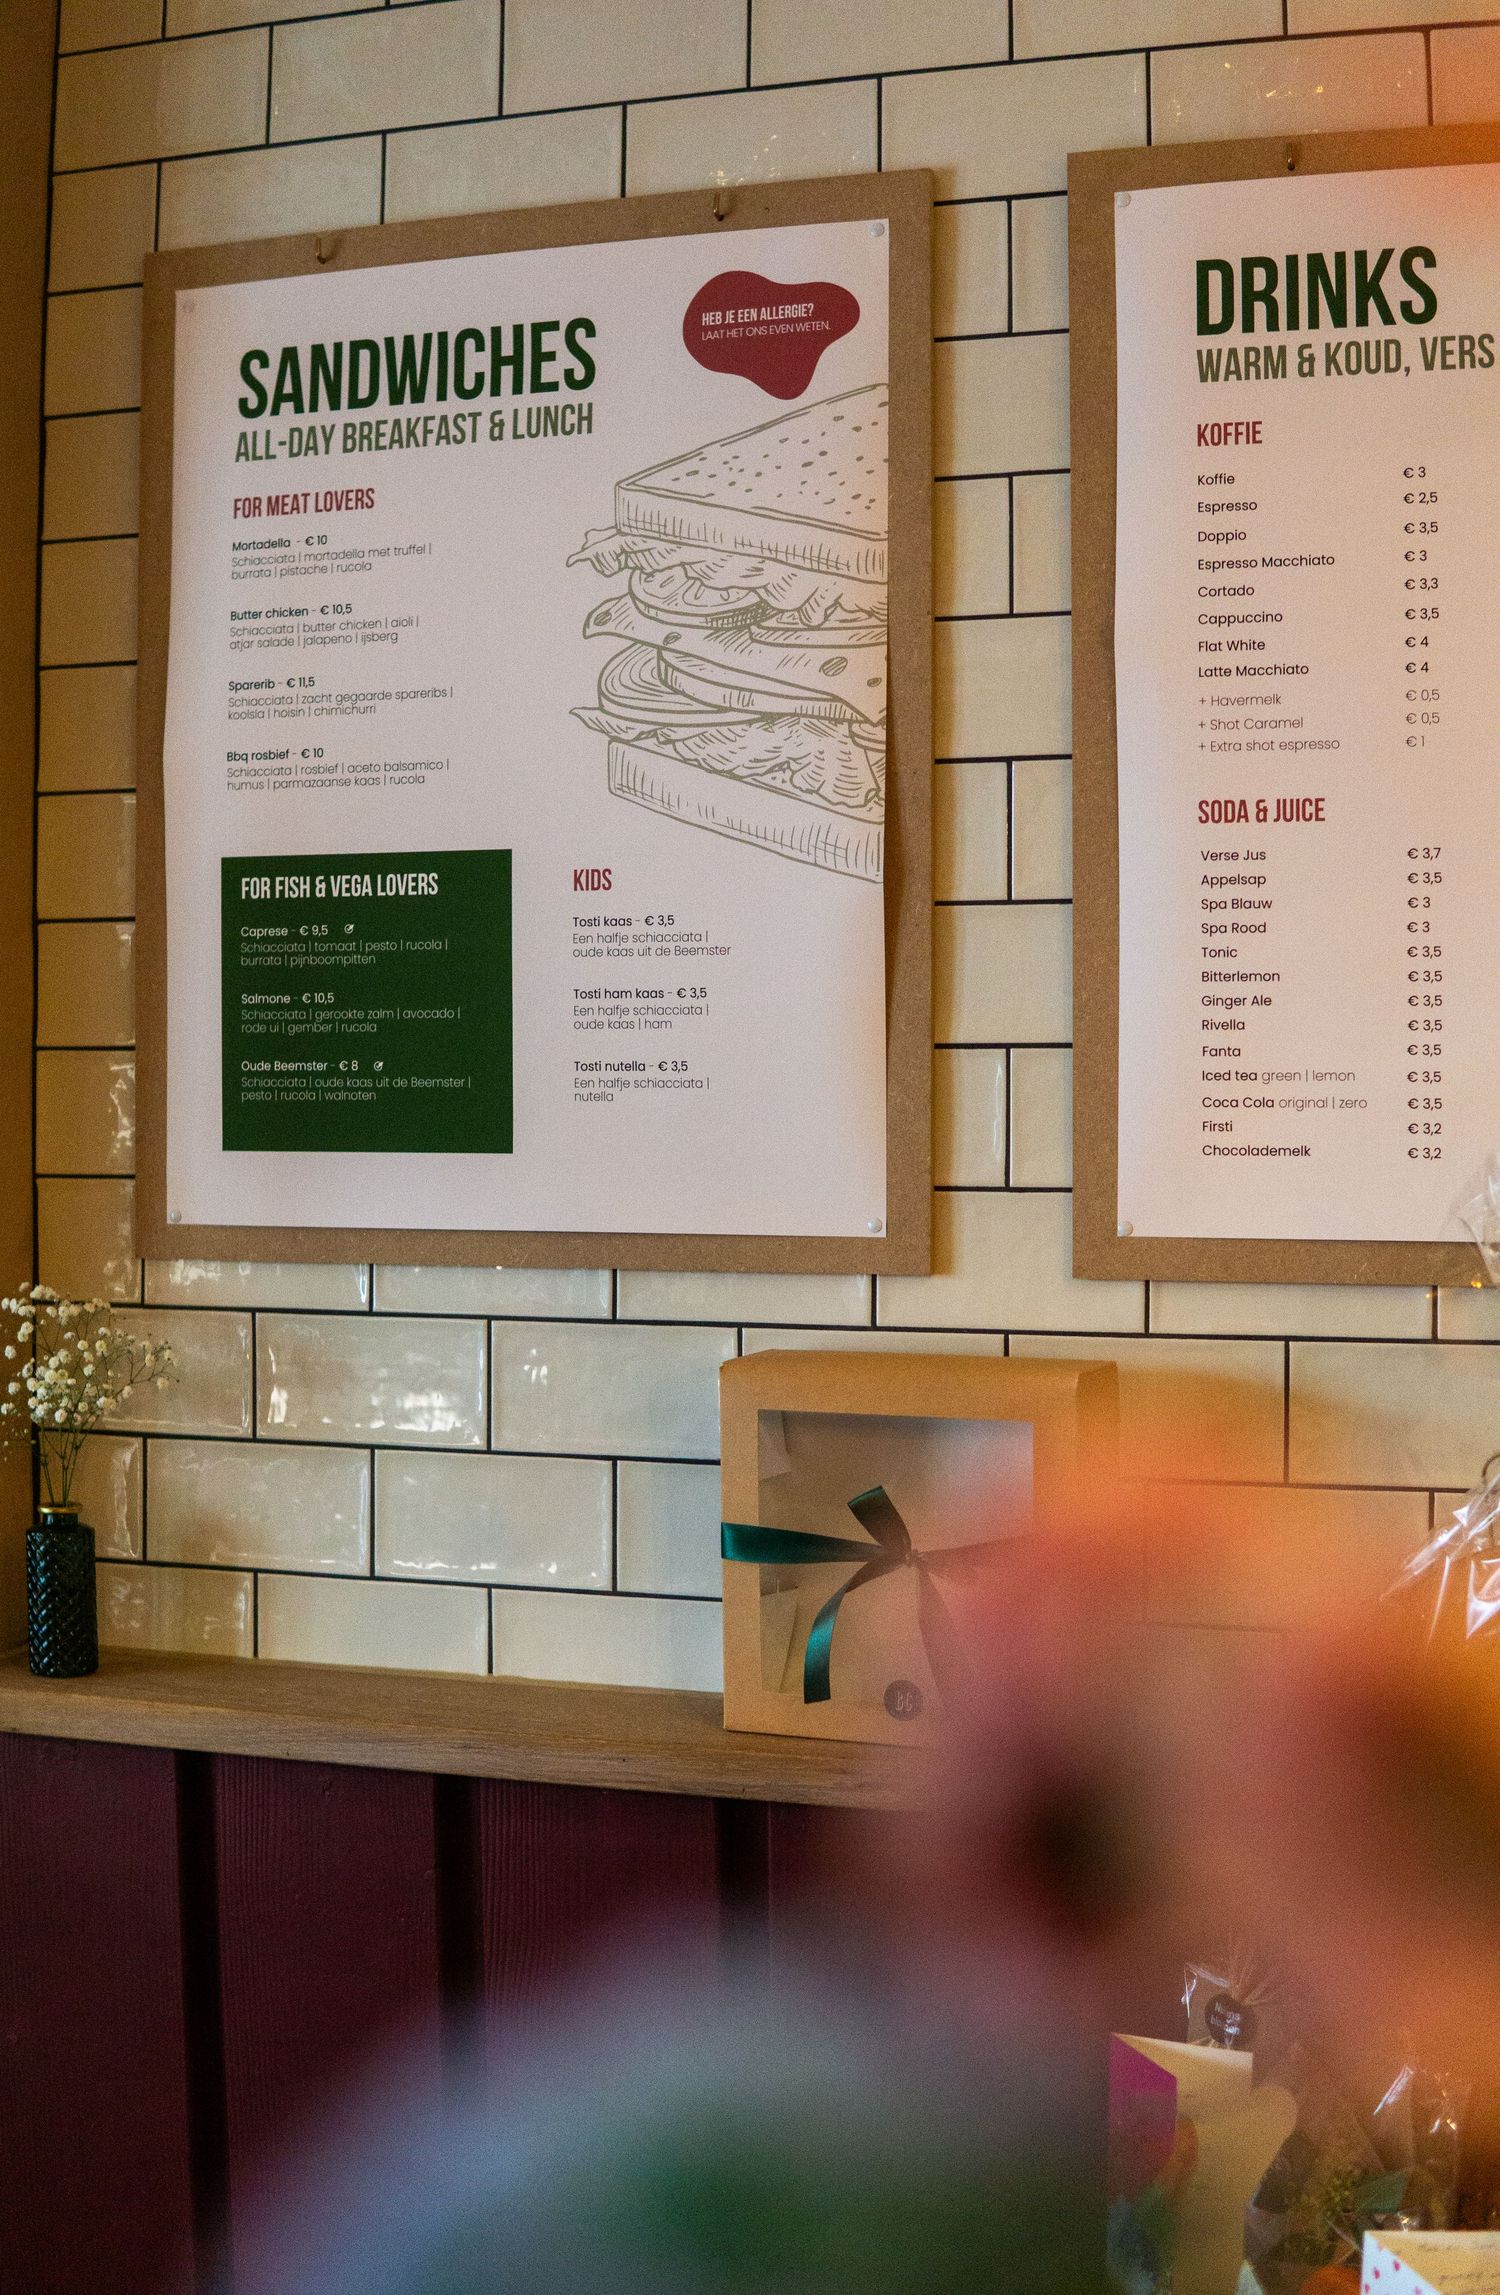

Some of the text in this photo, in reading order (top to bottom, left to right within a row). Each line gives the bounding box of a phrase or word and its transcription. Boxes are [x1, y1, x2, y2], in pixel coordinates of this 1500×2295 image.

[1196, 245, 1437, 335] DRINKS
[702, 303, 814, 325] HEB JE EEN ALLERGIE?
[701, 329, 724, 340] LAAT
[726, 327, 744, 338] HET
[745, 325, 767, 336] ONS
[769, 324, 794, 334] EVEN
[1196, 333, 1495, 382] WARM & KOUD, VERS
[238, 317, 596, 418] SANDWICHES
[235, 402, 592, 462] ALL-DAY BREAKFAST & LUNCH
[1197, 421, 1262, 446] KOFFIE
[1197, 473, 1235, 485] Koffie
[233, 488, 374, 519] FOR MEAT LOVERS
[1197, 501, 1257, 515] Espresso
[1197, 529, 1246, 544] Doppio
[232, 538, 291, 551] Mortadella
[232, 544, 425, 567] Schiacciata mortadella met truffel
[1198, 559, 1258, 572] Espresso
[1261, 554, 1335, 567] Macchiato
[231, 561, 372, 580] burrata pistache rucola
[1197, 584, 1254, 597] Cortado
[230, 607, 309, 621] Butter chicken
[1197, 611, 1283, 628] Cappuccino
[230, 616, 413, 638] Schiacciata butter chicken aioli
[229, 632, 398, 652] atjar salade jalapeno ijsberg
[1198, 639, 1265, 652] Flat White
[1198, 663, 1309, 677] Latte Macchiato
[228, 678, 275, 693] Sparerib
[1210, 693, 1281, 706] Havermelk
[1210, 716, 1303, 730] Shot Caramel
[1210, 739, 1340, 753] Extra shot espresso
[226, 748, 289, 764] Bbq rosbief
[1198, 798, 1325, 823] SODA & JUICE
[1200, 850, 1266, 861] Verse Jus
[242, 872, 438, 898] FOR FISH & VEGA LOVERS
[573, 868, 612, 891] KIDS
[1200, 874, 1266, 888] Appelsap
[1201, 898, 1272, 912] Spa Blauw
[572, 916, 632, 927] Tosti kaas
[240, 926, 288, 939] Caprese
[1201, 922, 1266, 937] Spa Rood
[572, 931, 702, 947] Een halfje schiacciata
[572, 945, 730, 957] oude kaas uit de Beemster
[1201, 946, 1237, 958] Tonic
[1201, 970, 1280, 982] Bitterlemon
[241, 993, 290, 1004] Salmone
[573, 988, 664, 999] Tosti ham kaas
[1201, 994, 1272, 1009] Ginger Ale
[241, 1008, 454, 1024] Schiacciata gerookte zalm avocado
[573, 1004, 702, 1019] Een halfje schiacciata
[241, 1020, 377, 1036] rode ui gember rucola
[573, 1018, 672, 1029] oude kaas ham
[1201, 1018, 1245, 1030] Rivella
[1202, 1046, 1240, 1057] Fanta
[241, 1060, 328, 1071] Oude Beemster
[573, 1060, 645, 1071] Tosti nutella
[241, 1076, 464, 1089] Schiacciata oude kaas uit de Beemster
[1202, 1070, 1355, 1084] Iced tea green lemon
[574, 1077, 703, 1092] Een halfje schiacciata
[241, 1090, 376, 1102] pesto rucola walnoten
[574, 1090, 614, 1102] nutella
[1201, 1096, 1367, 1111] Coca Cola original zero
[1202, 1120, 1232, 1132] Firsti
[1202, 1144, 1310, 1156] Chocolademelk
